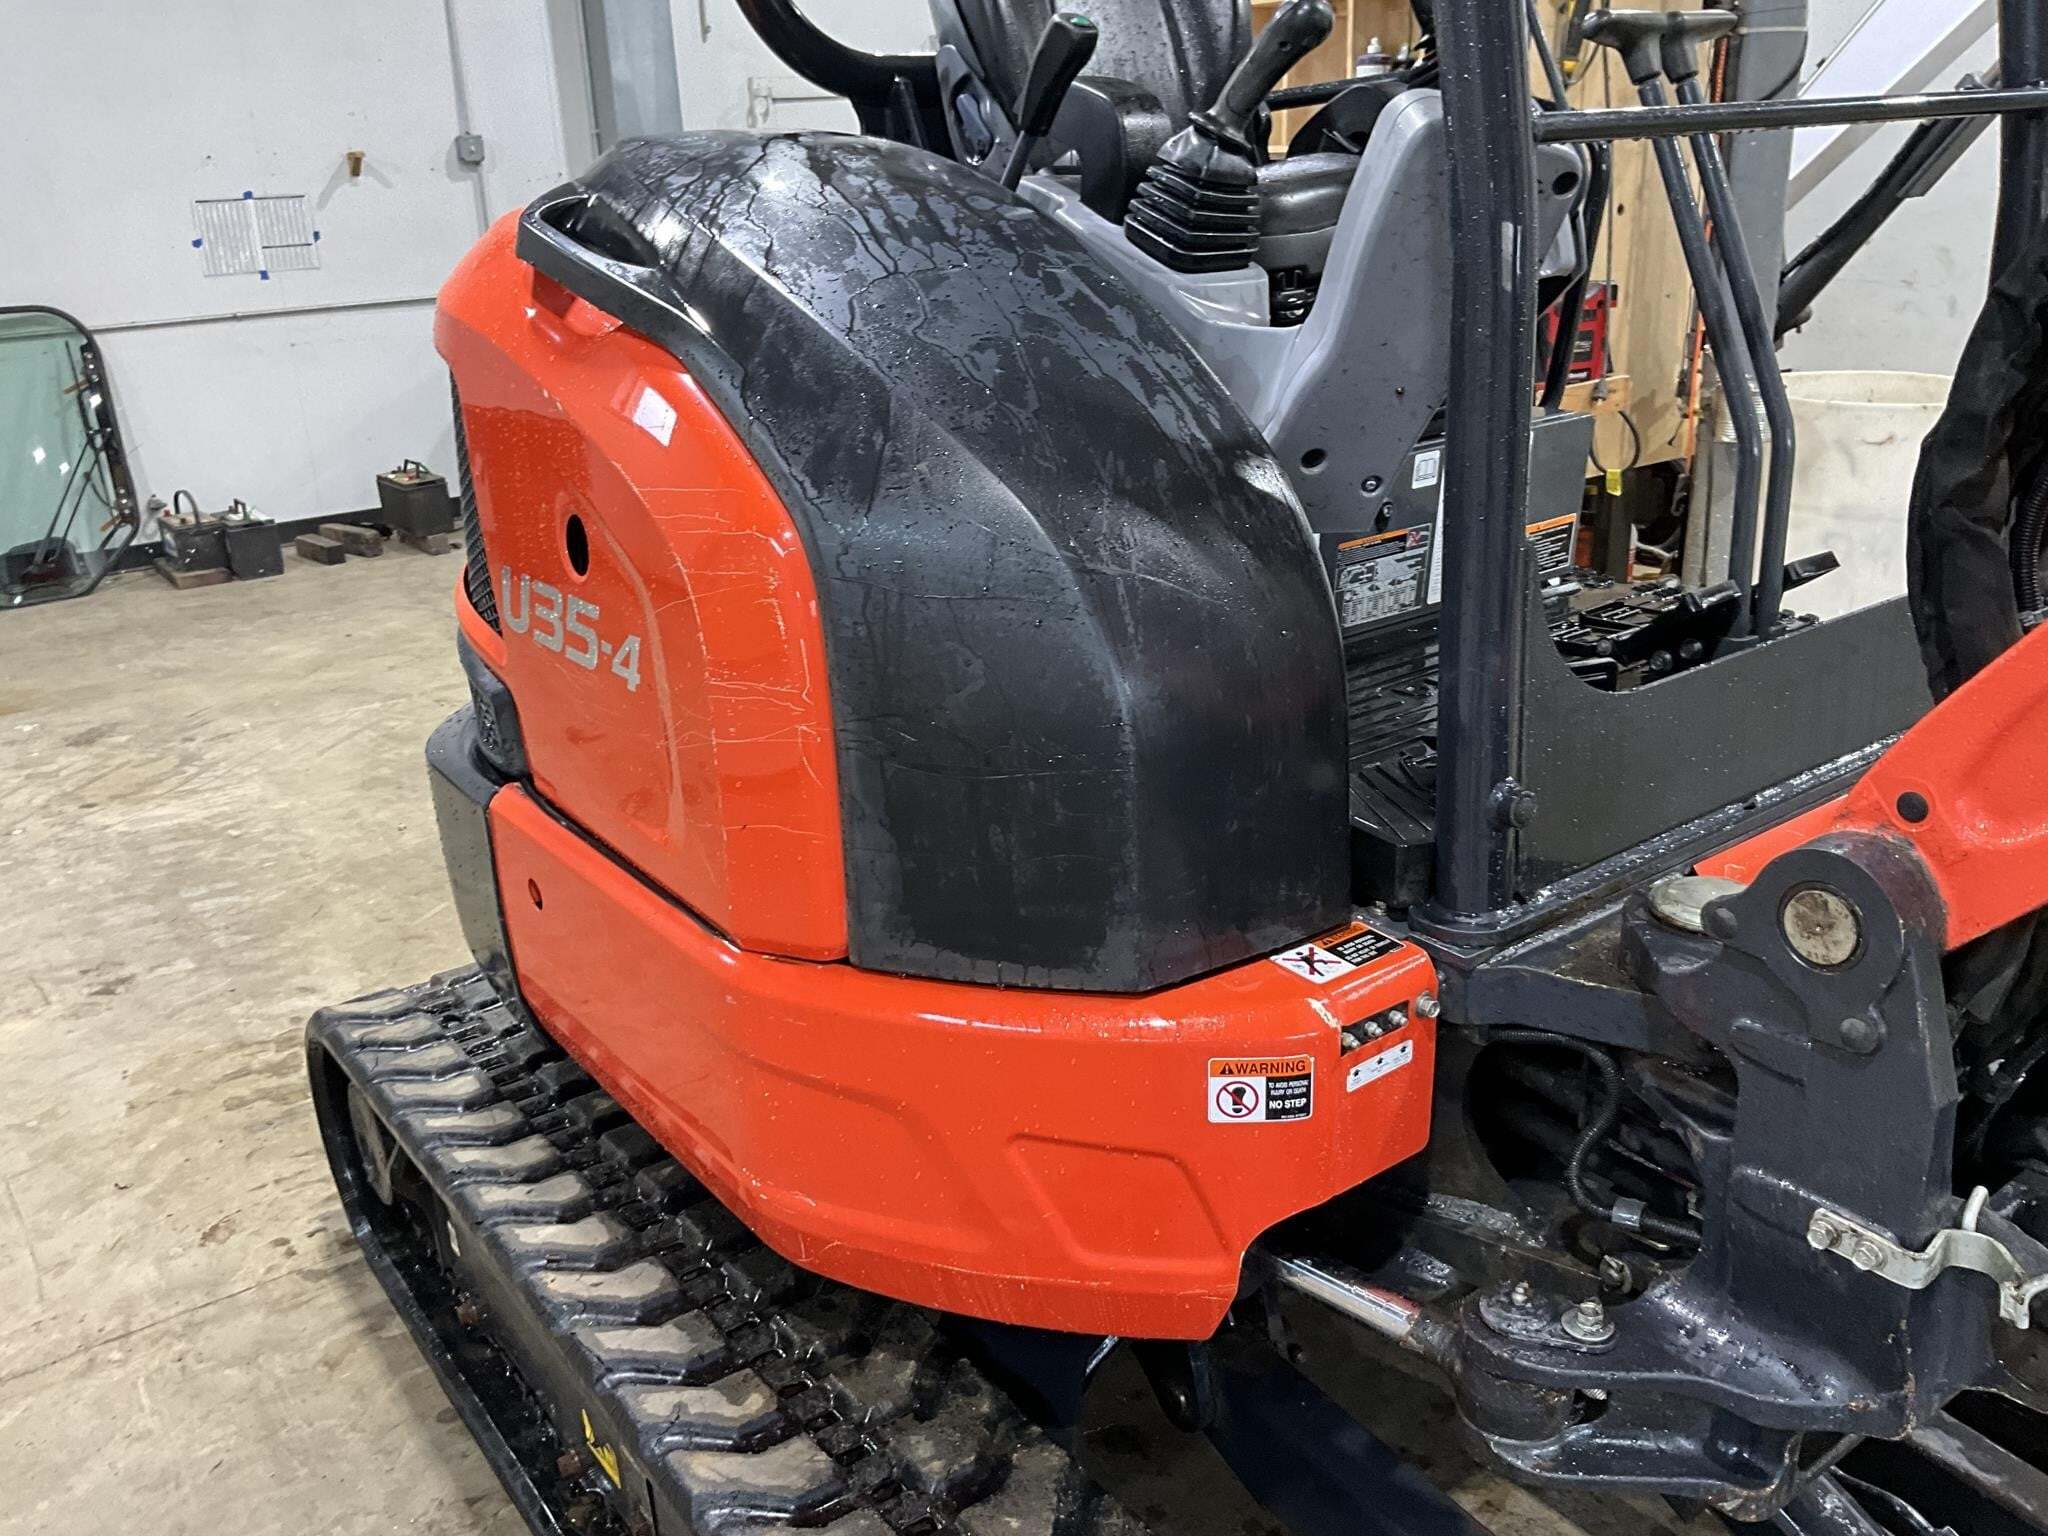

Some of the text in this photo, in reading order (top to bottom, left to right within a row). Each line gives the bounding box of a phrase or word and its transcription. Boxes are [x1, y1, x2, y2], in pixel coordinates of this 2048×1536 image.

[501, 565, 641, 692] U35-4
[1235, 1060, 1306, 1075] WARNING
[1269, 1098, 1307, 1109] NO STEP
